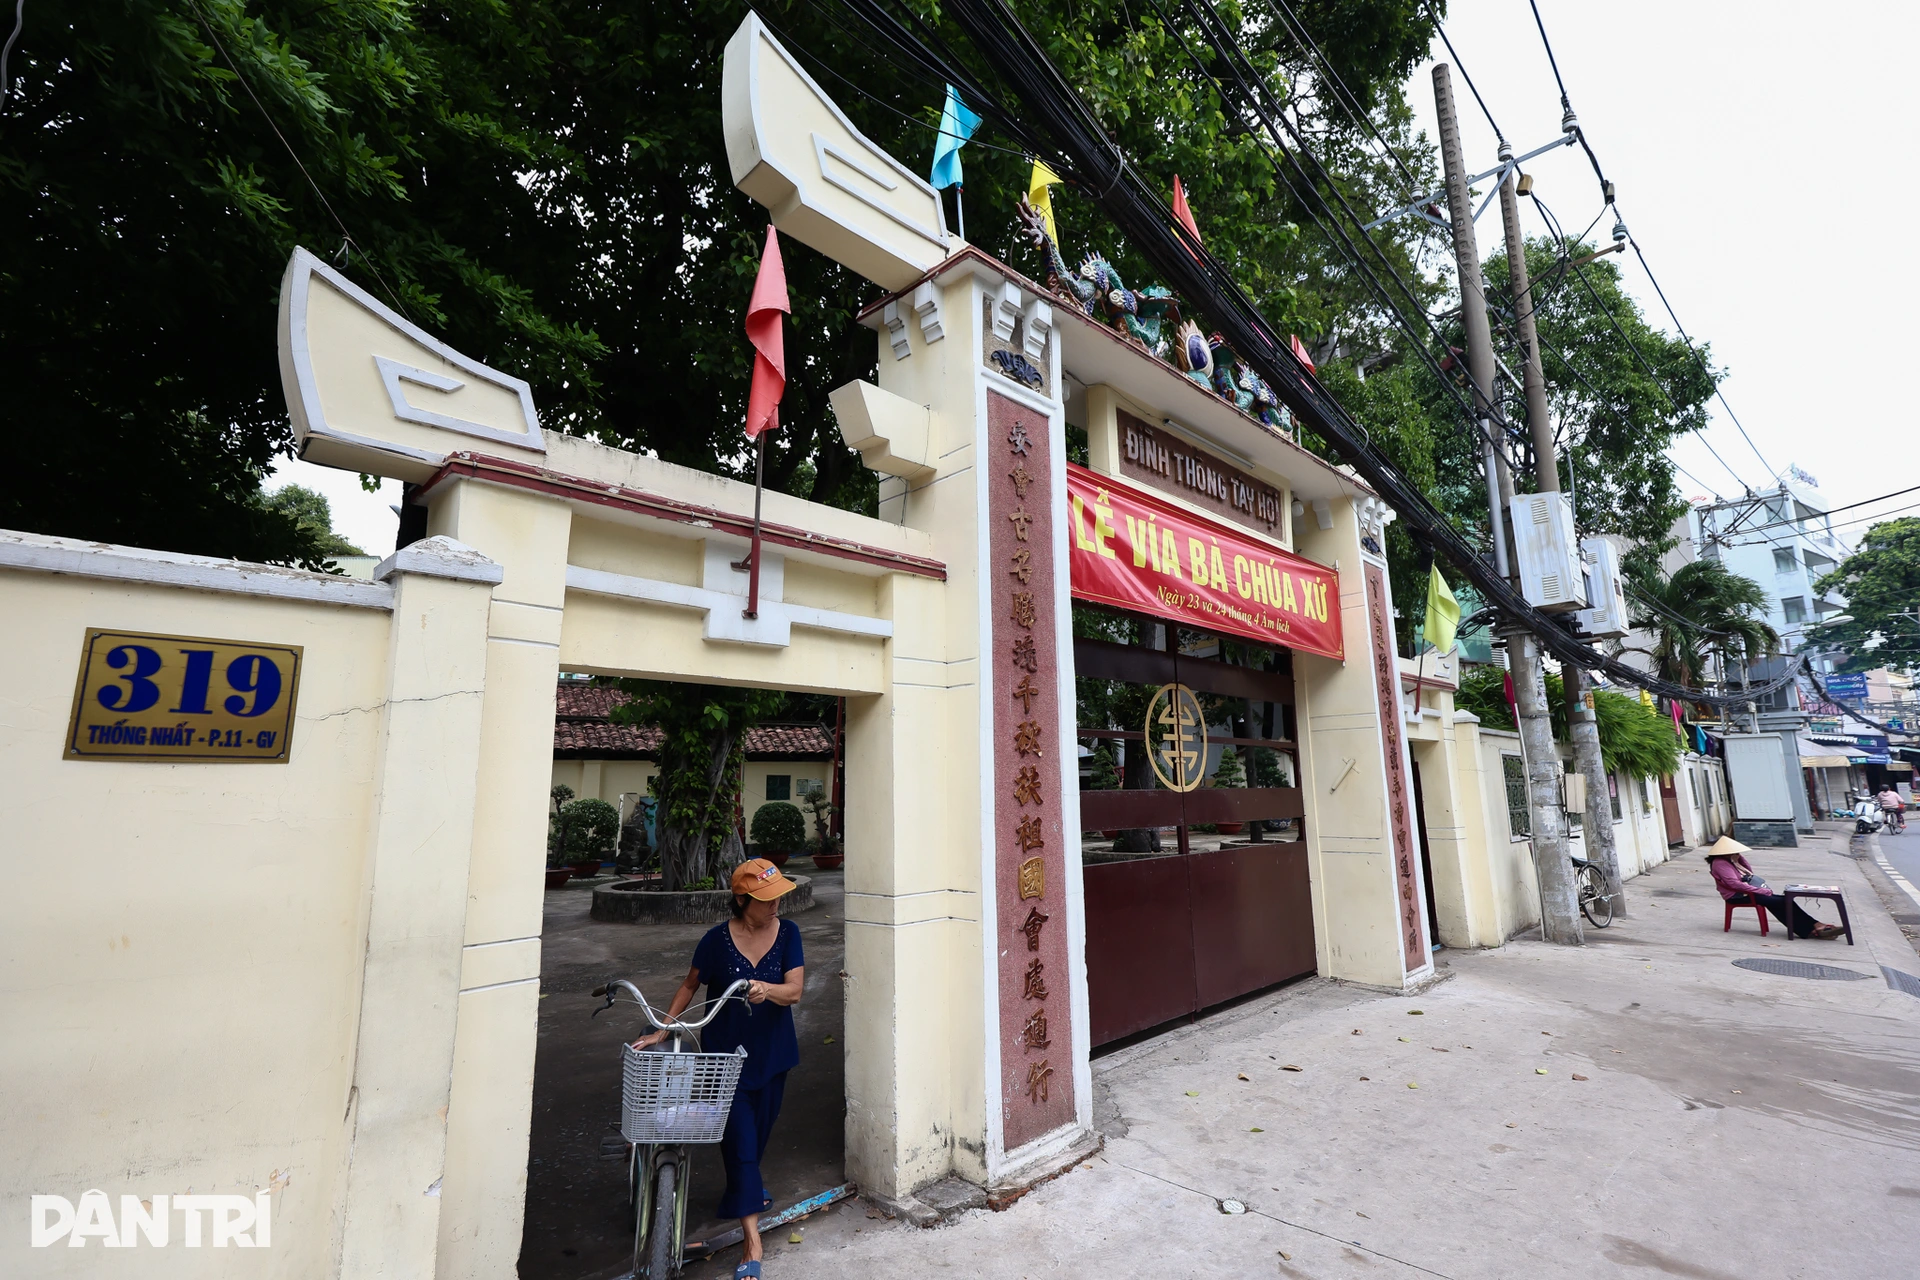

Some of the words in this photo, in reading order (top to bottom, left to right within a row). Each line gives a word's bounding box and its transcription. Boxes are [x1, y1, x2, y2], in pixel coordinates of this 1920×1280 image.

[1072, 487, 1116, 561] LỄ
[1125, 513, 1183, 580] VÍA
[1188, 535, 1229, 594] BÀ
[1233, 554, 1299, 614] CHÚA
[1299, 576, 1329, 624] XỨ
[1155, 585, 1186, 609] Ngày
[1186, 593, 1200, 609] 23
[1202, 597, 1213, 613] và
[1215, 601, 1227, 616] 24
[1227, 605, 1253, 626] tháng
[1253, 612, 1260, 625] 4
[1260, 610, 1275, 630] Âm
[1276, 618, 1290, 634] lịch
[97, 645, 283, 718] 319
[88, 718, 148, 746] THỐNG
[150, 722, 196, 747] NHẤT
[209, 729, 243, 748] P.11
[256, 730, 278, 749] GV
